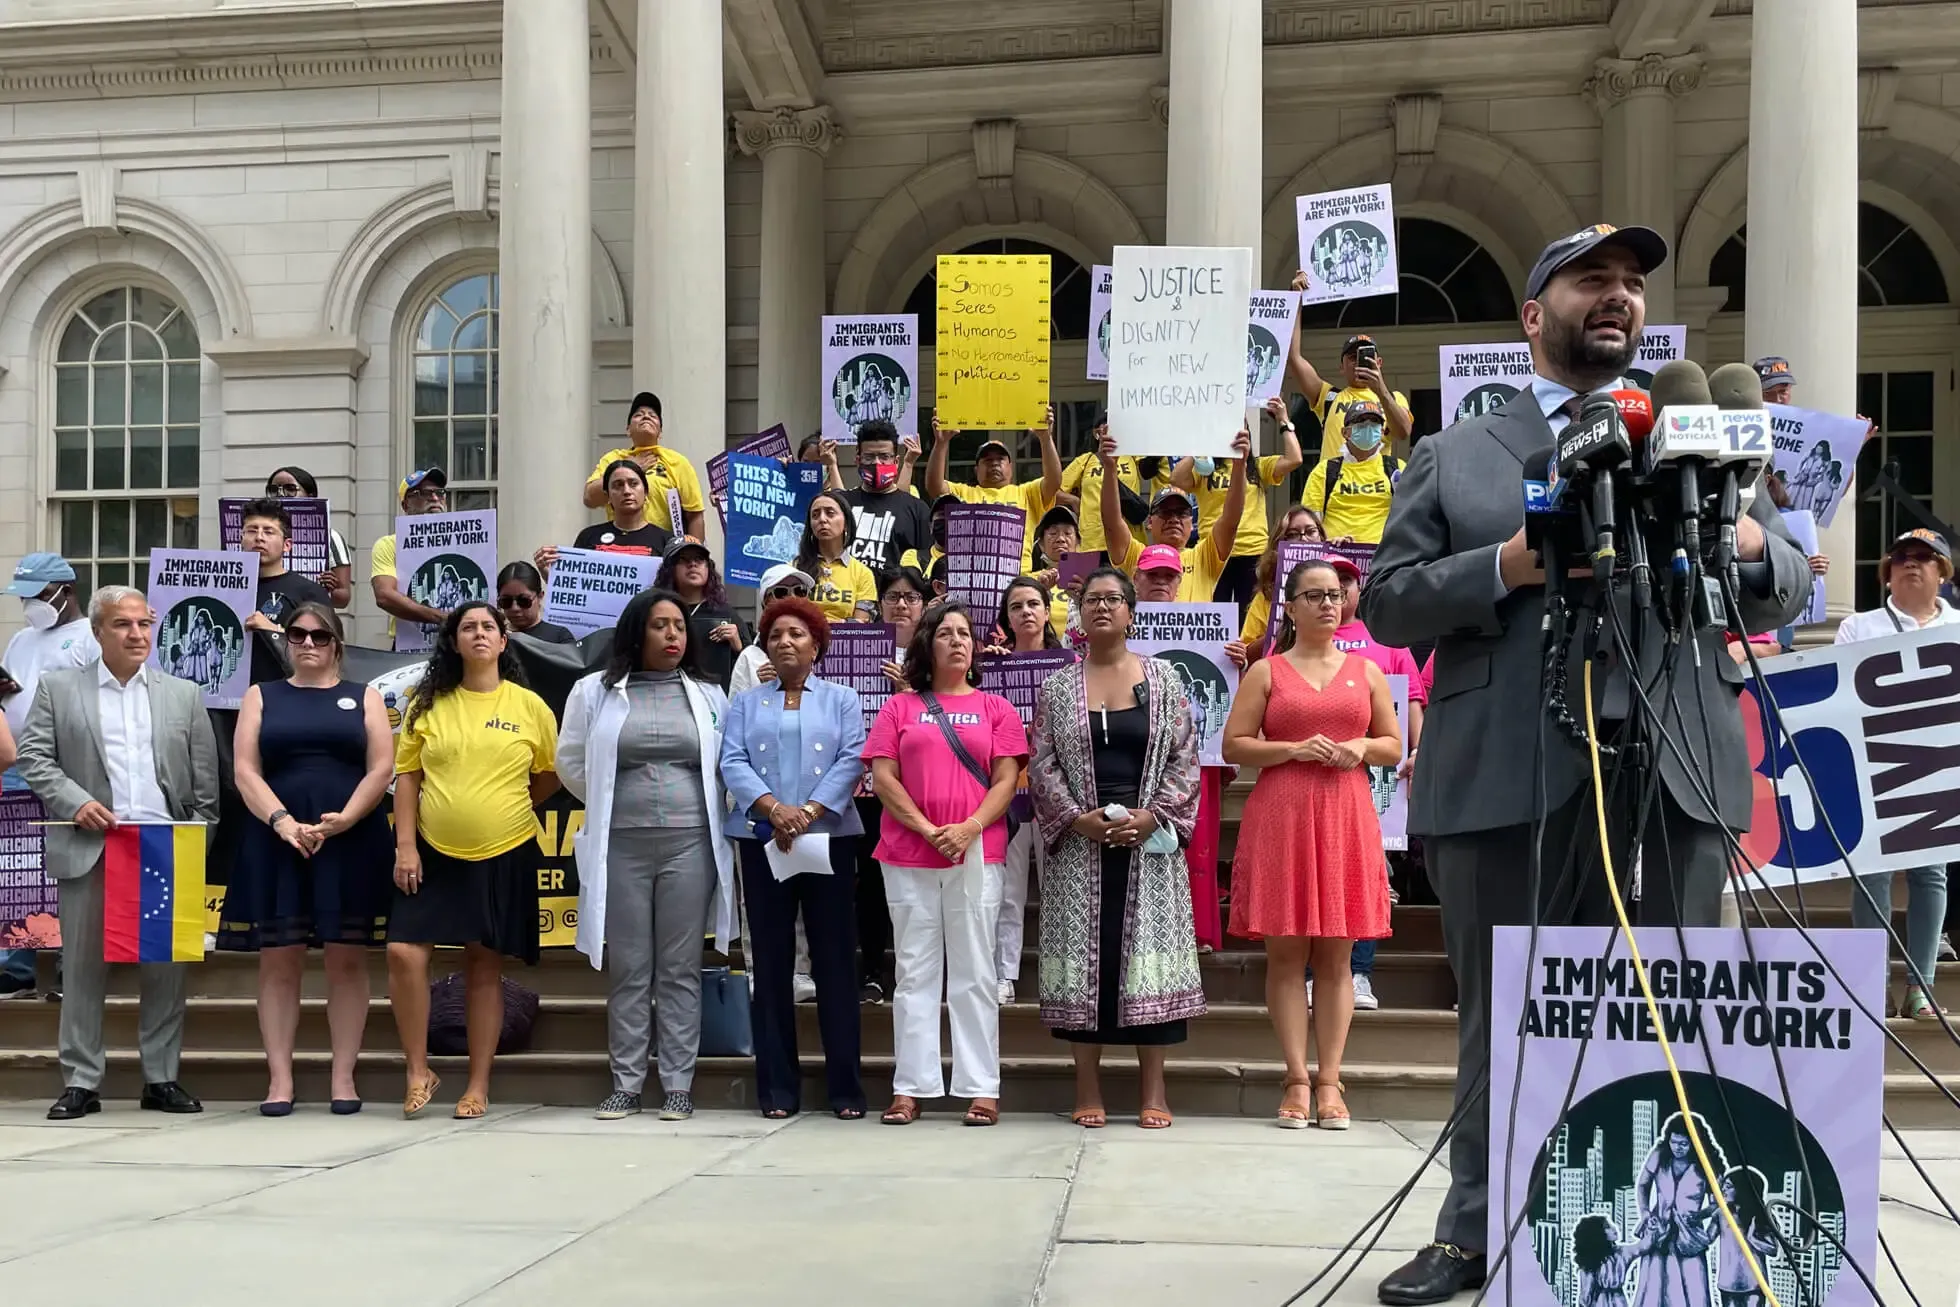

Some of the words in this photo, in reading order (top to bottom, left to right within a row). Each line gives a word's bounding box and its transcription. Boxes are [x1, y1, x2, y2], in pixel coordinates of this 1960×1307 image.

[1310, 193, 1378, 210] IMMIGRANTS
[1305, 211, 1324, 220] ARE
[1328, 206, 1350, 218] NEW
[1354, 201, 1385, 214] YORK!
[950, 274, 1014, 297] Somos
[1134, 266, 1223, 302] JUSTICE
[952, 300, 995, 314] Seres
[1172, 296, 1182, 311] &
[1258, 309, 1290, 320] YORK!
[836, 322, 904, 334] IMMIGRANTS
[954, 322, 1016, 340] Humanos
[1122, 319, 1200, 344] DIGNITY
[830, 336, 849, 346] ARE
[852, 335, 876, 346] NEW
[879, 334, 910, 346] YORK!
[1454, 352, 1529, 364] IMMIGRANTS
[1640, 348, 1676, 360] YORK!
[1170, 354, 1208, 376] NEW
[1449, 366, 1470, 378] ARE
[1474, 365, 1499, 376] NEW
[1120, 384, 1235, 409] IMMIGRANTS
[1692, 416, 1714, 431] 41
[1722, 414, 1764, 423] news
[1724, 424, 1766, 450] 12
[1561, 431, 1592, 462] NEWS
[734, 463, 770, 482] THIS
[772, 470, 786, 488] IS
[734, 480, 762, 500] OUR
[766, 486, 796, 507] NEW
[1340, 477, 1386, 494] NICE
[734, 496, 776, 520] YORK!
[292, 514, 324, 528] DIGNITY
[409, 519, 482, 536] IMMIGRANTS
[292, 529, 325, 542] DIGNITY
[948, 520, 974, 535] WELCOME
[976, 520, 999, 536] WITH
[1001, 521, 1024, 540] DIGNITY
[403, 538, 424, 550] ARE
[427, 534, 452, 548] NEW
[456, 531, 488, 545] YORK!
[948, 537, 973, 552] WELCOME
[975, 537, 998, 552] WITH
[1000, 539, 1022, 557] DIGNITY
[292, 544, 326, 557] DIGNITY
[852, 539, 886, 562] CAL
[164, 558, 243, 575] IMMIGRANTS
[292, 558, 326, 572] DIGNITY
[555, 559, 638, 578] IMMIGRANTS
[862, 561, 884, 570] ORK
[948, 555, 972, 570] WELCOME
[974, 555, 997, 571] WITH
[998, 557, 1020, 576] DIGNITY
[156, 572, 179, 586] ARE
[182, 574, 211, 588] NEW
[214, 575, 249, 590] YORK!
[553, 576, 577, 589] ARE
[581, 578, 642, 596] WELCOME
[948, 572, 970, 588] WELCOME
[972, 573, 996, 590] WITH
[551, 592, 587, 606] HERE!
[972, 591, 994, 606] WITH
[1134, 612, 1221, 626] IMMIGRANTS
[1153, 627, 1184, 640] NEW
[1188, 627, 1230, 641] YORK!
[853, 640, 892, 655] DIGNITY
[824, 658, 850, 674] WITH
[1005, 670, 1030, 686] WITH
[1006, 688, 1032, 704] WITH
[1542, 957, 1826, 1003] IMMIGRANTS
[1517, 1000, 1592, 1040] ARE
[1607, 1002, 1702, 1044] NEW
[1716, 1006, 1852, 1050] YORK!
